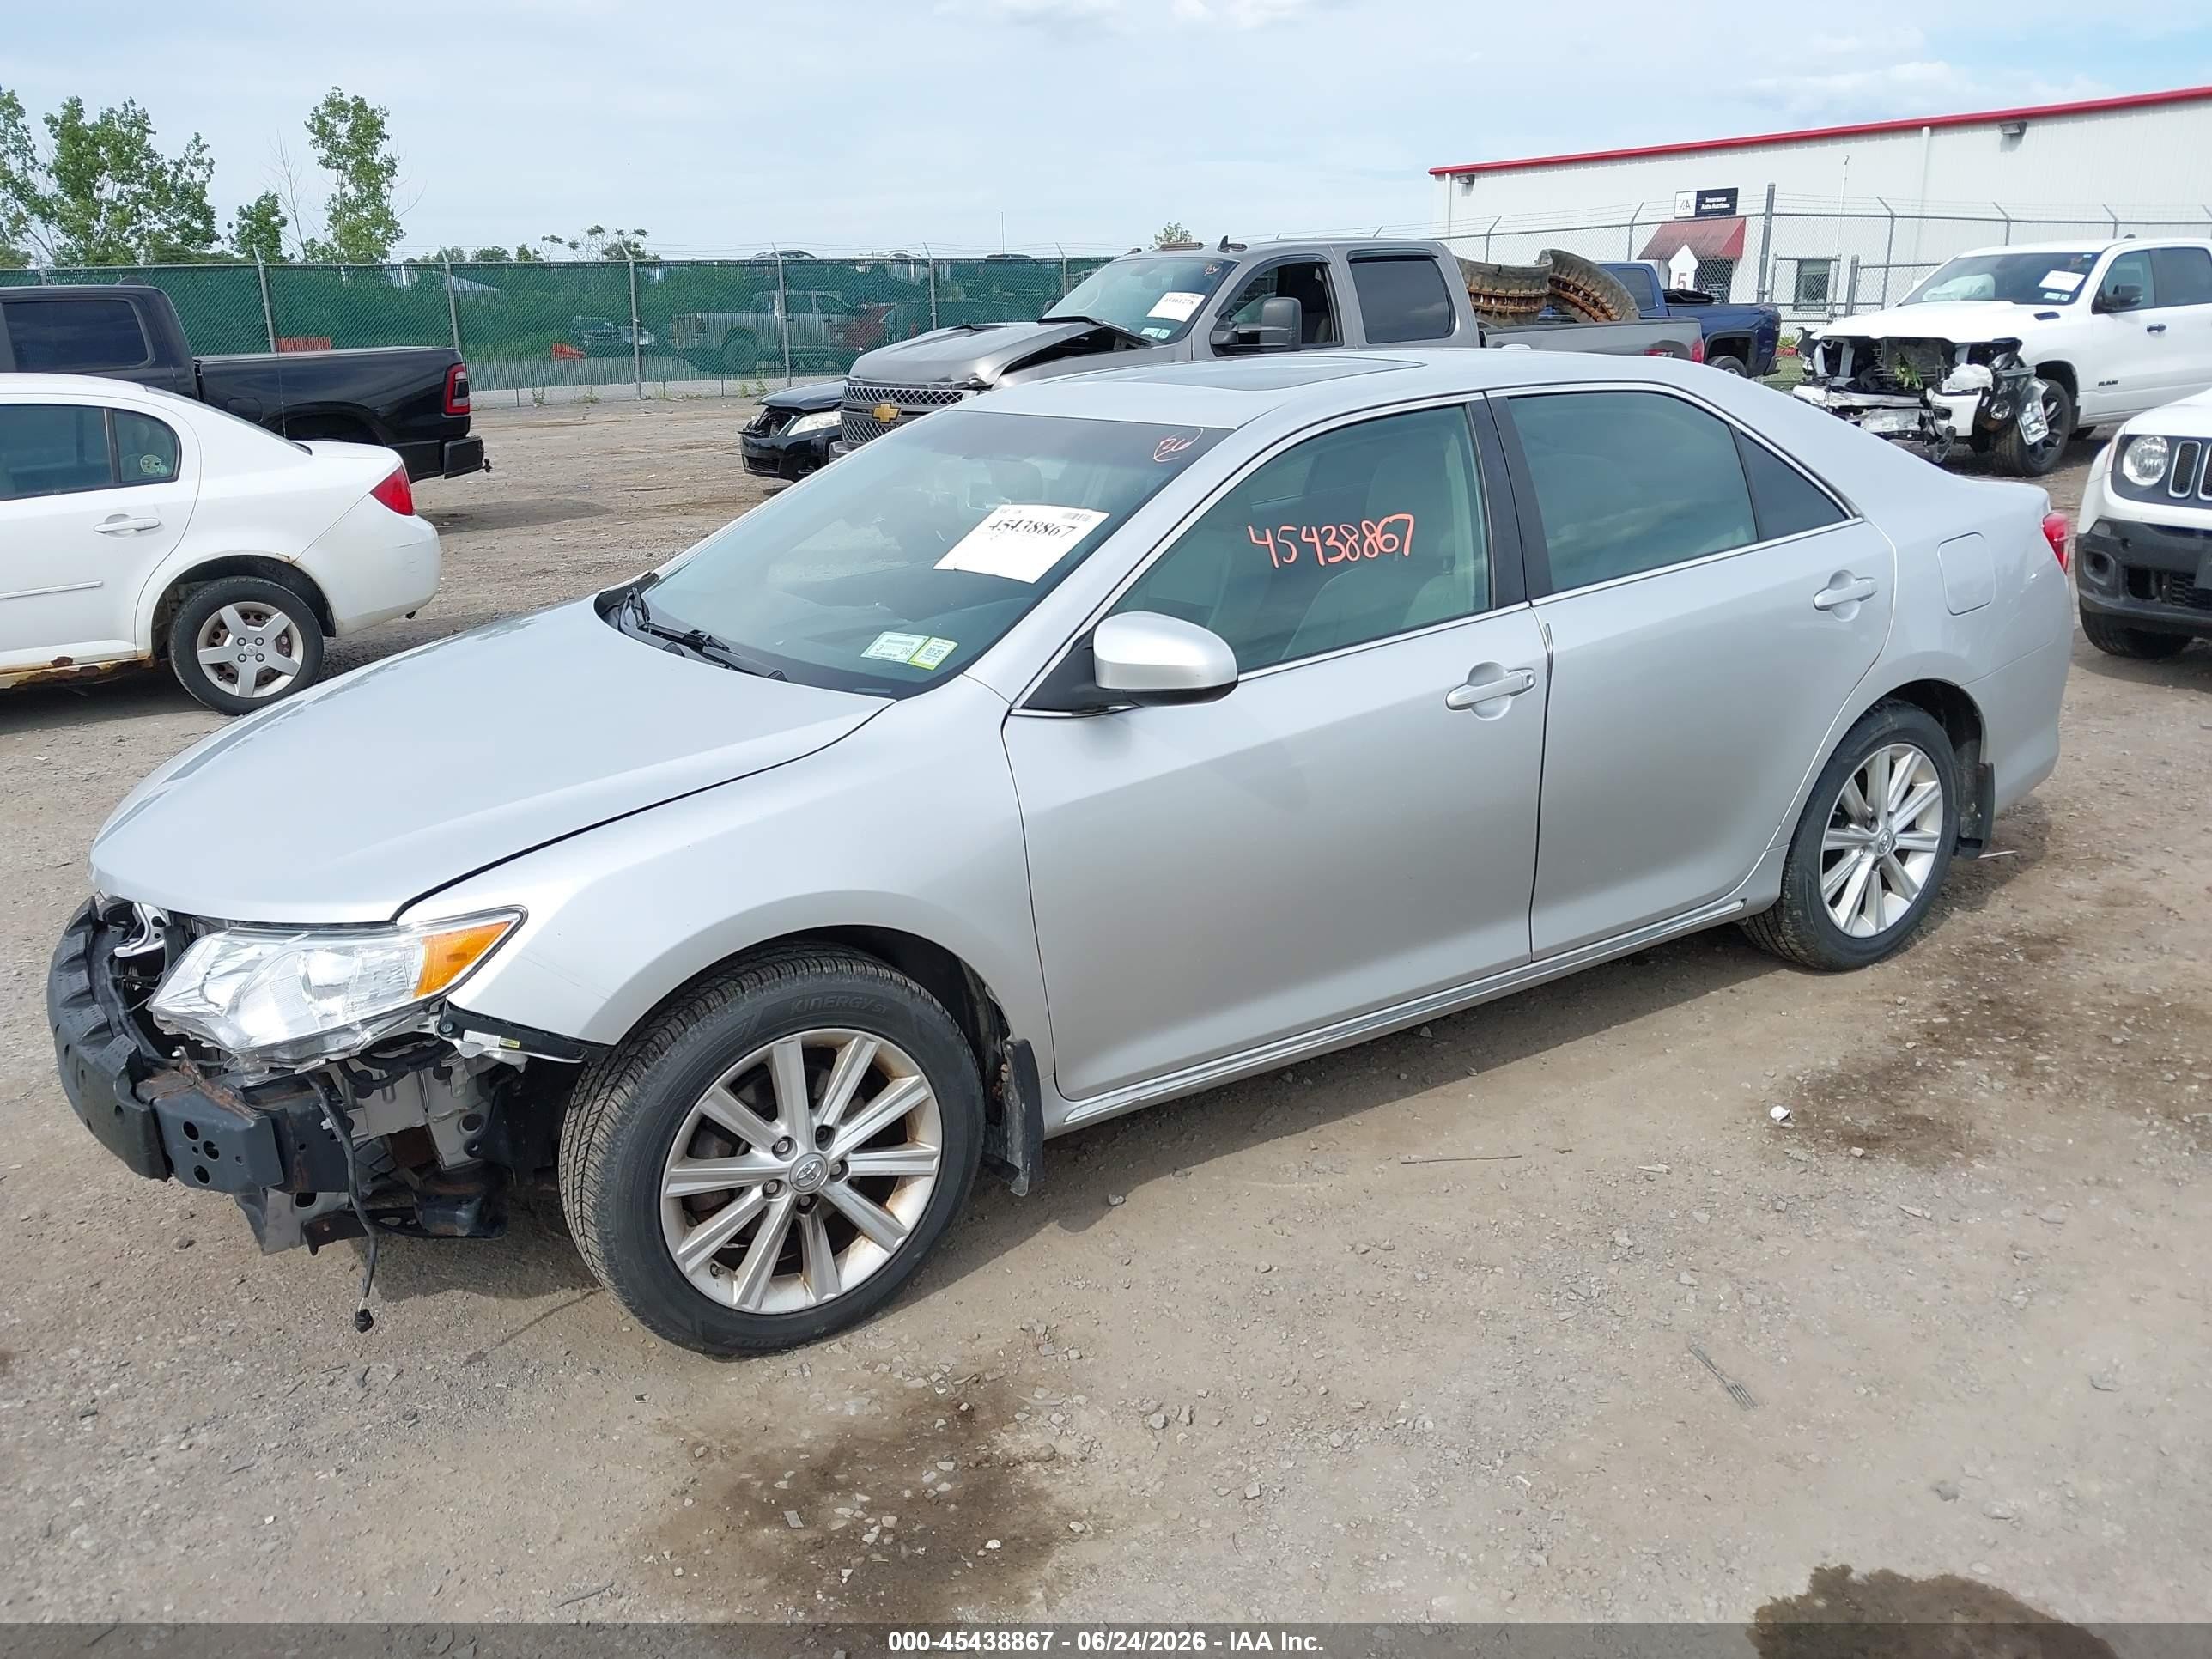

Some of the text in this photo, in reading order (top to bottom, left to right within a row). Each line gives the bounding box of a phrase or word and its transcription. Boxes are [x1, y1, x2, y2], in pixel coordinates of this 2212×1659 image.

[1677, 272, 1686, 289] 5
[989, 519, 1078, 538] 45438867
[1247, 513, 1415, 568] 45438867
